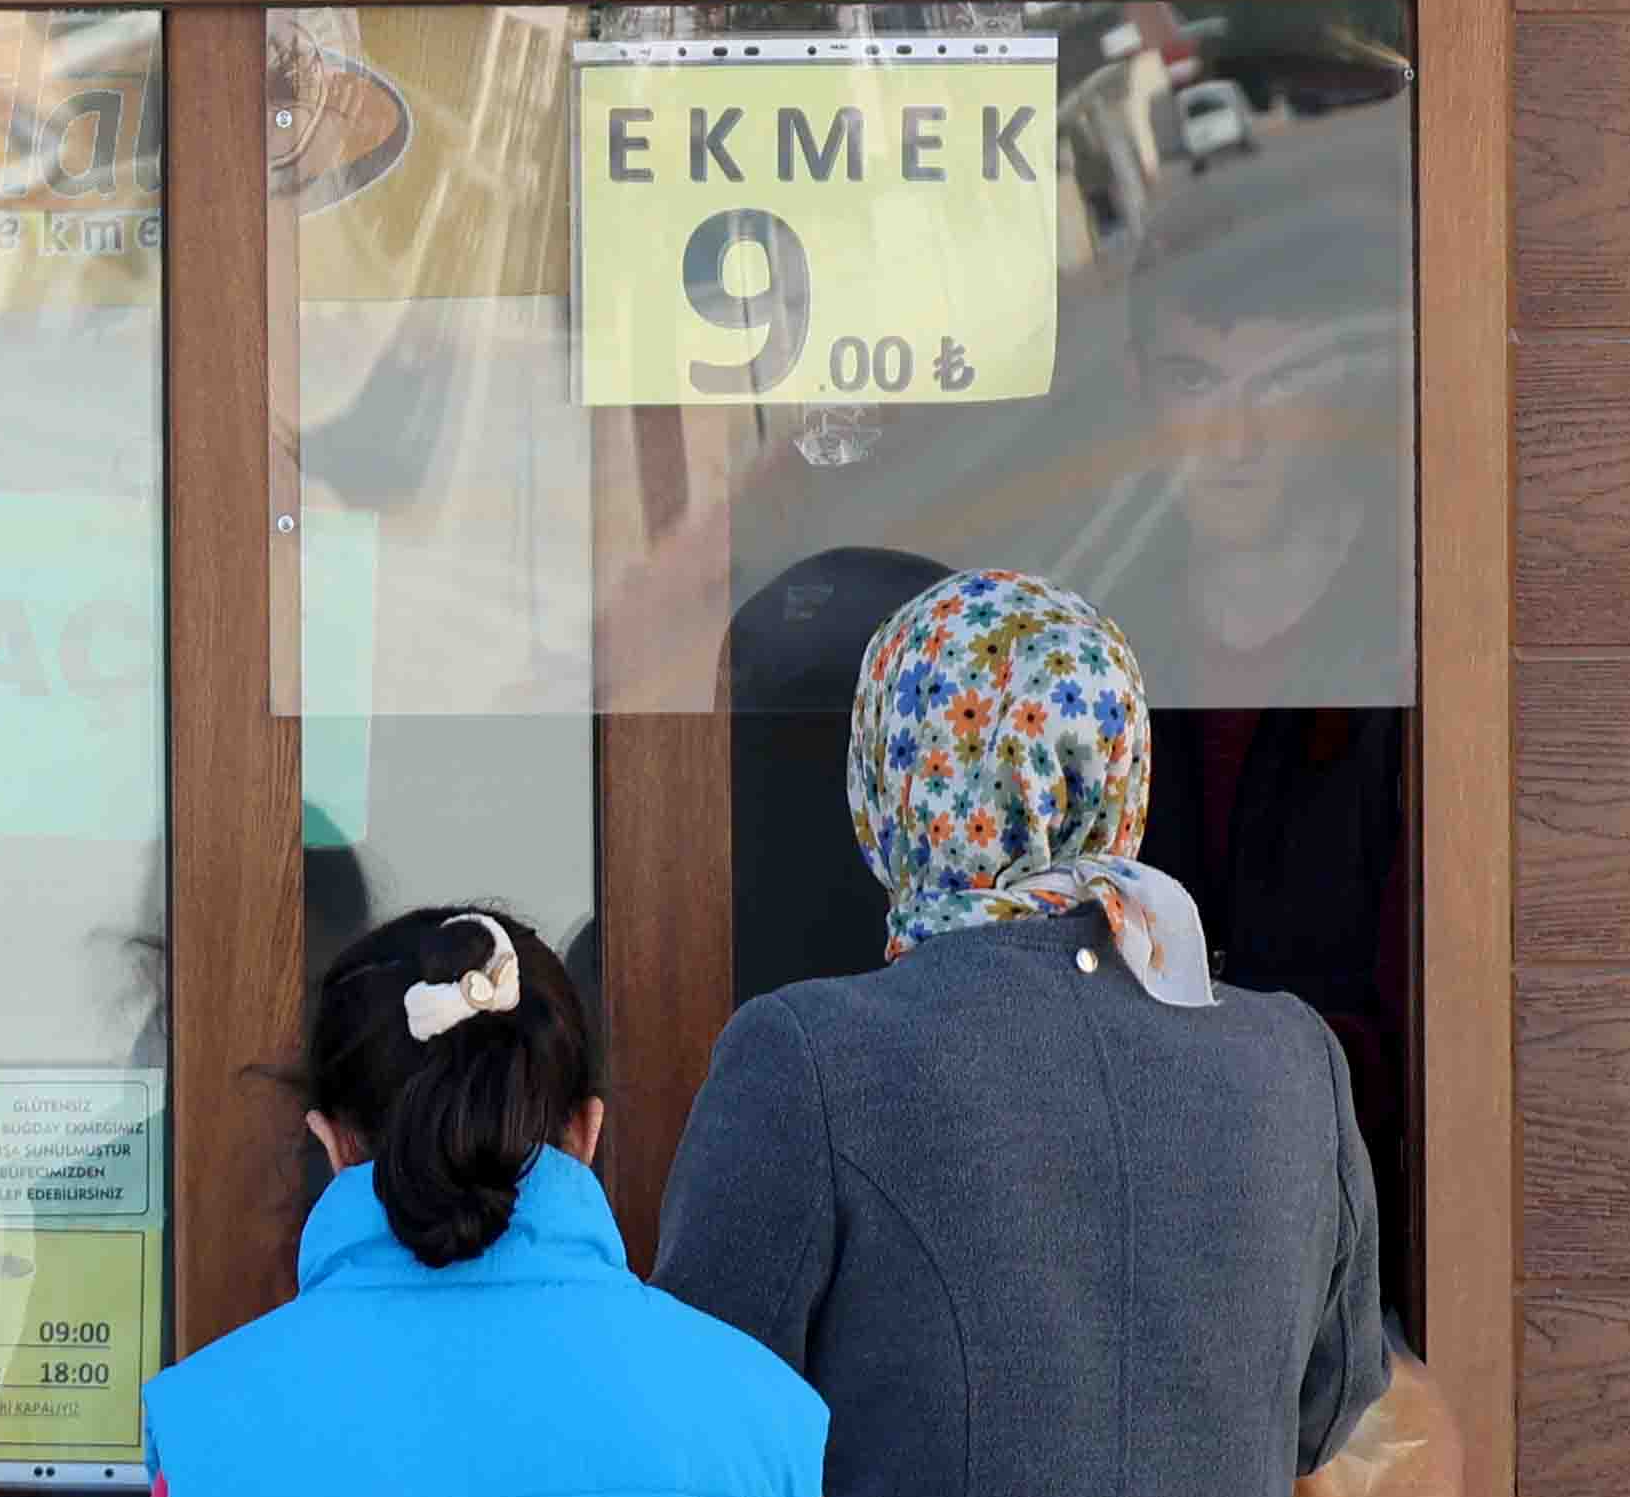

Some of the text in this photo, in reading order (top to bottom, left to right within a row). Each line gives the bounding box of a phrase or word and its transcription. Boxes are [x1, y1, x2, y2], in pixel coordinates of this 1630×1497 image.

[607, 106, 1037, 183] EKMEK
[681, 207, 914, 396] 9.00
[1, 1118, 60, 1136] BUĞDAY
[39, 1320, 111, 1345] 09:00
[39, 1361, 110, 1385] 18:00
